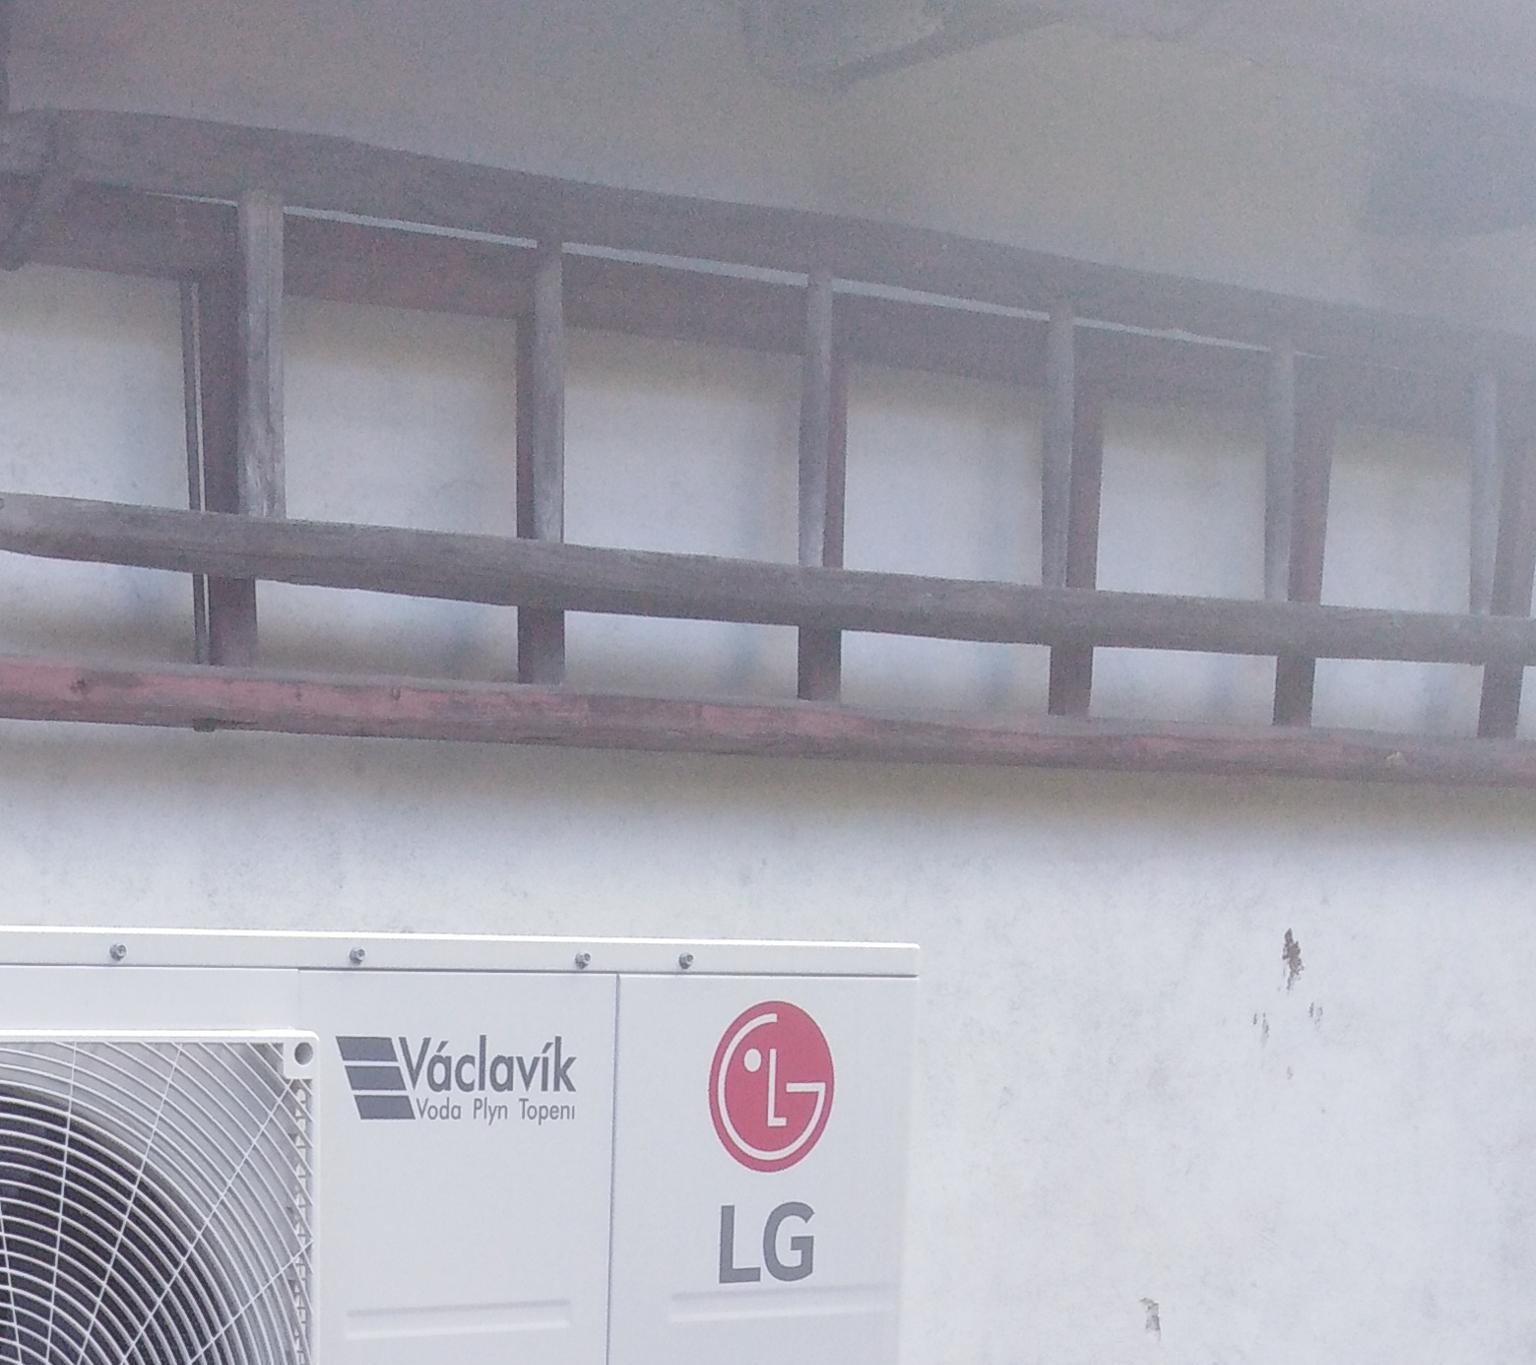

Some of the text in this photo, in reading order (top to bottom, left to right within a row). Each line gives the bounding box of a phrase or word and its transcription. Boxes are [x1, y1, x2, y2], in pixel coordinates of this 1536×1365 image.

[398, 1035, 577, 1093] Václavík
[415, 1097, 462, 1121] Voda
[473, 1096, 508, 1126] Plyn
[718, 1201, 816, 1285] LG
